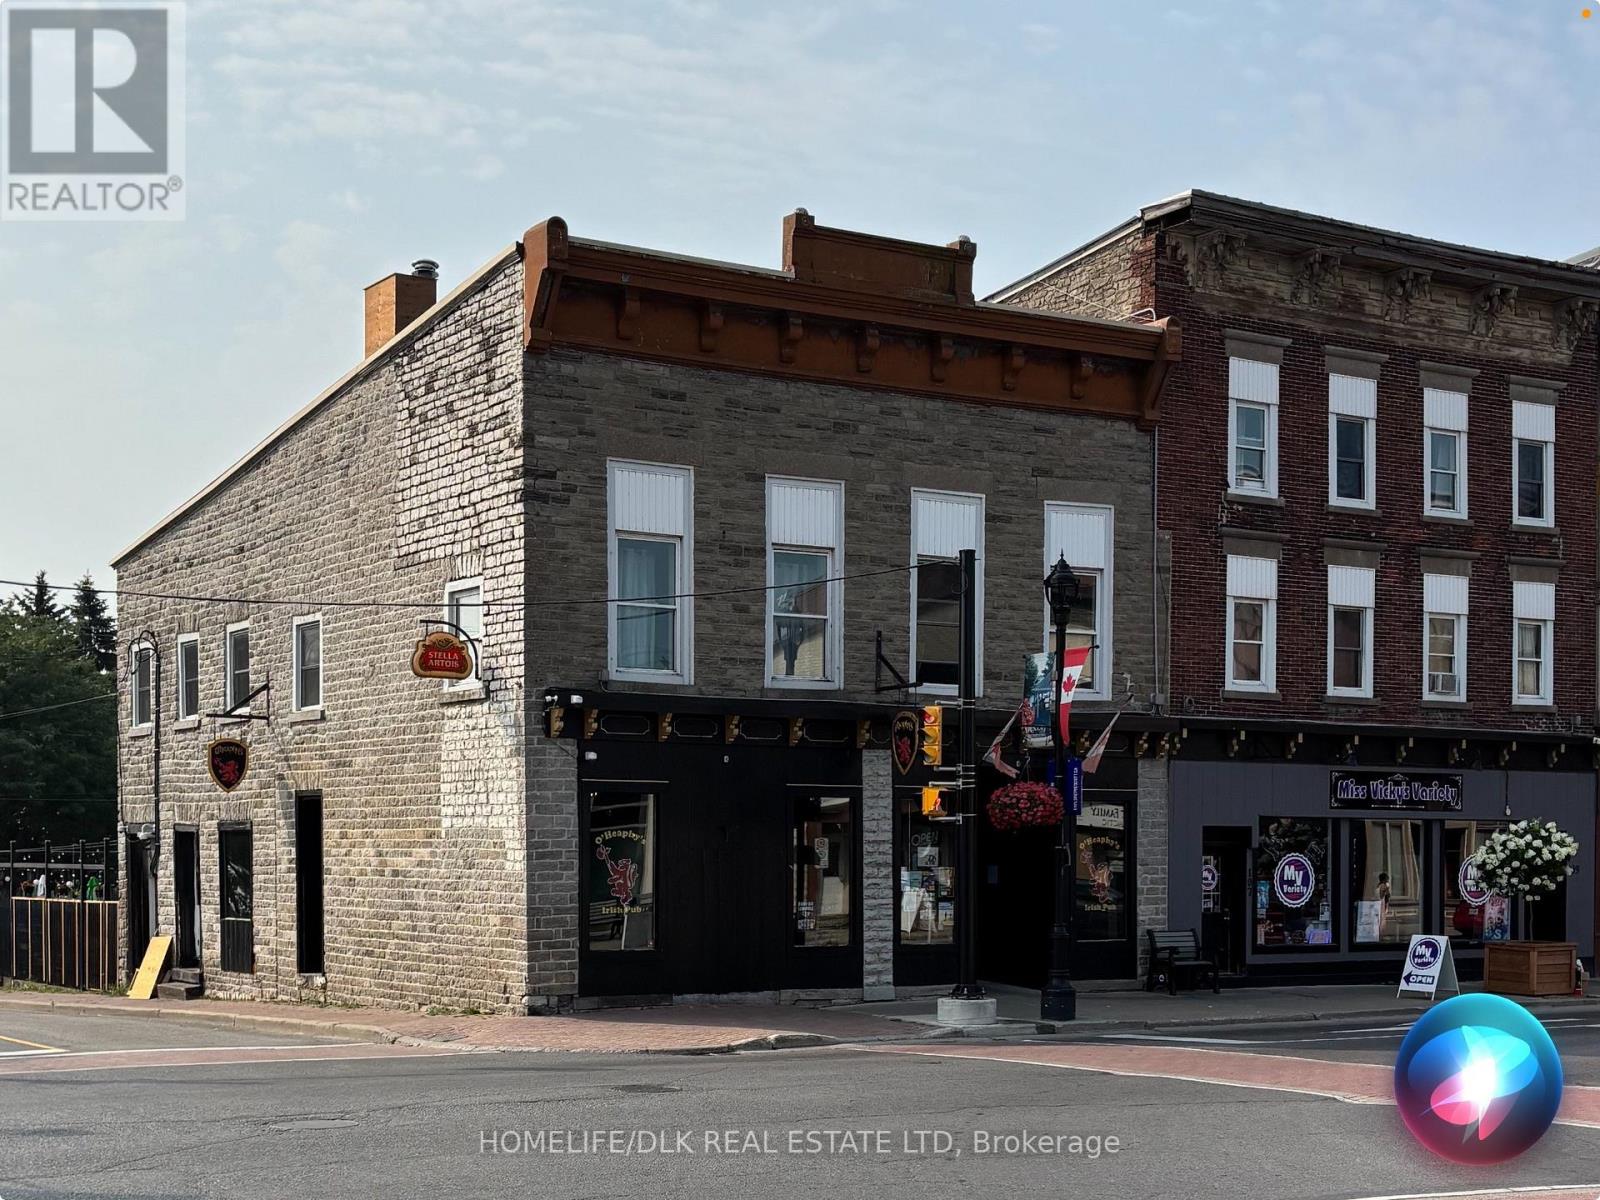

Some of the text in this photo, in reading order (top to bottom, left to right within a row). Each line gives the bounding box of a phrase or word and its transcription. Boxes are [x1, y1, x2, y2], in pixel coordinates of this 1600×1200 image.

[428, 651, 459, 660] STELLA
[428, 659, 459, 668] ARTOIS
[1337, 778, 1457, 806] Miss Vicky's Variety
[1283, 884, 1307, 895] Variety
[1409, 975, 1433, 984] OPEN
